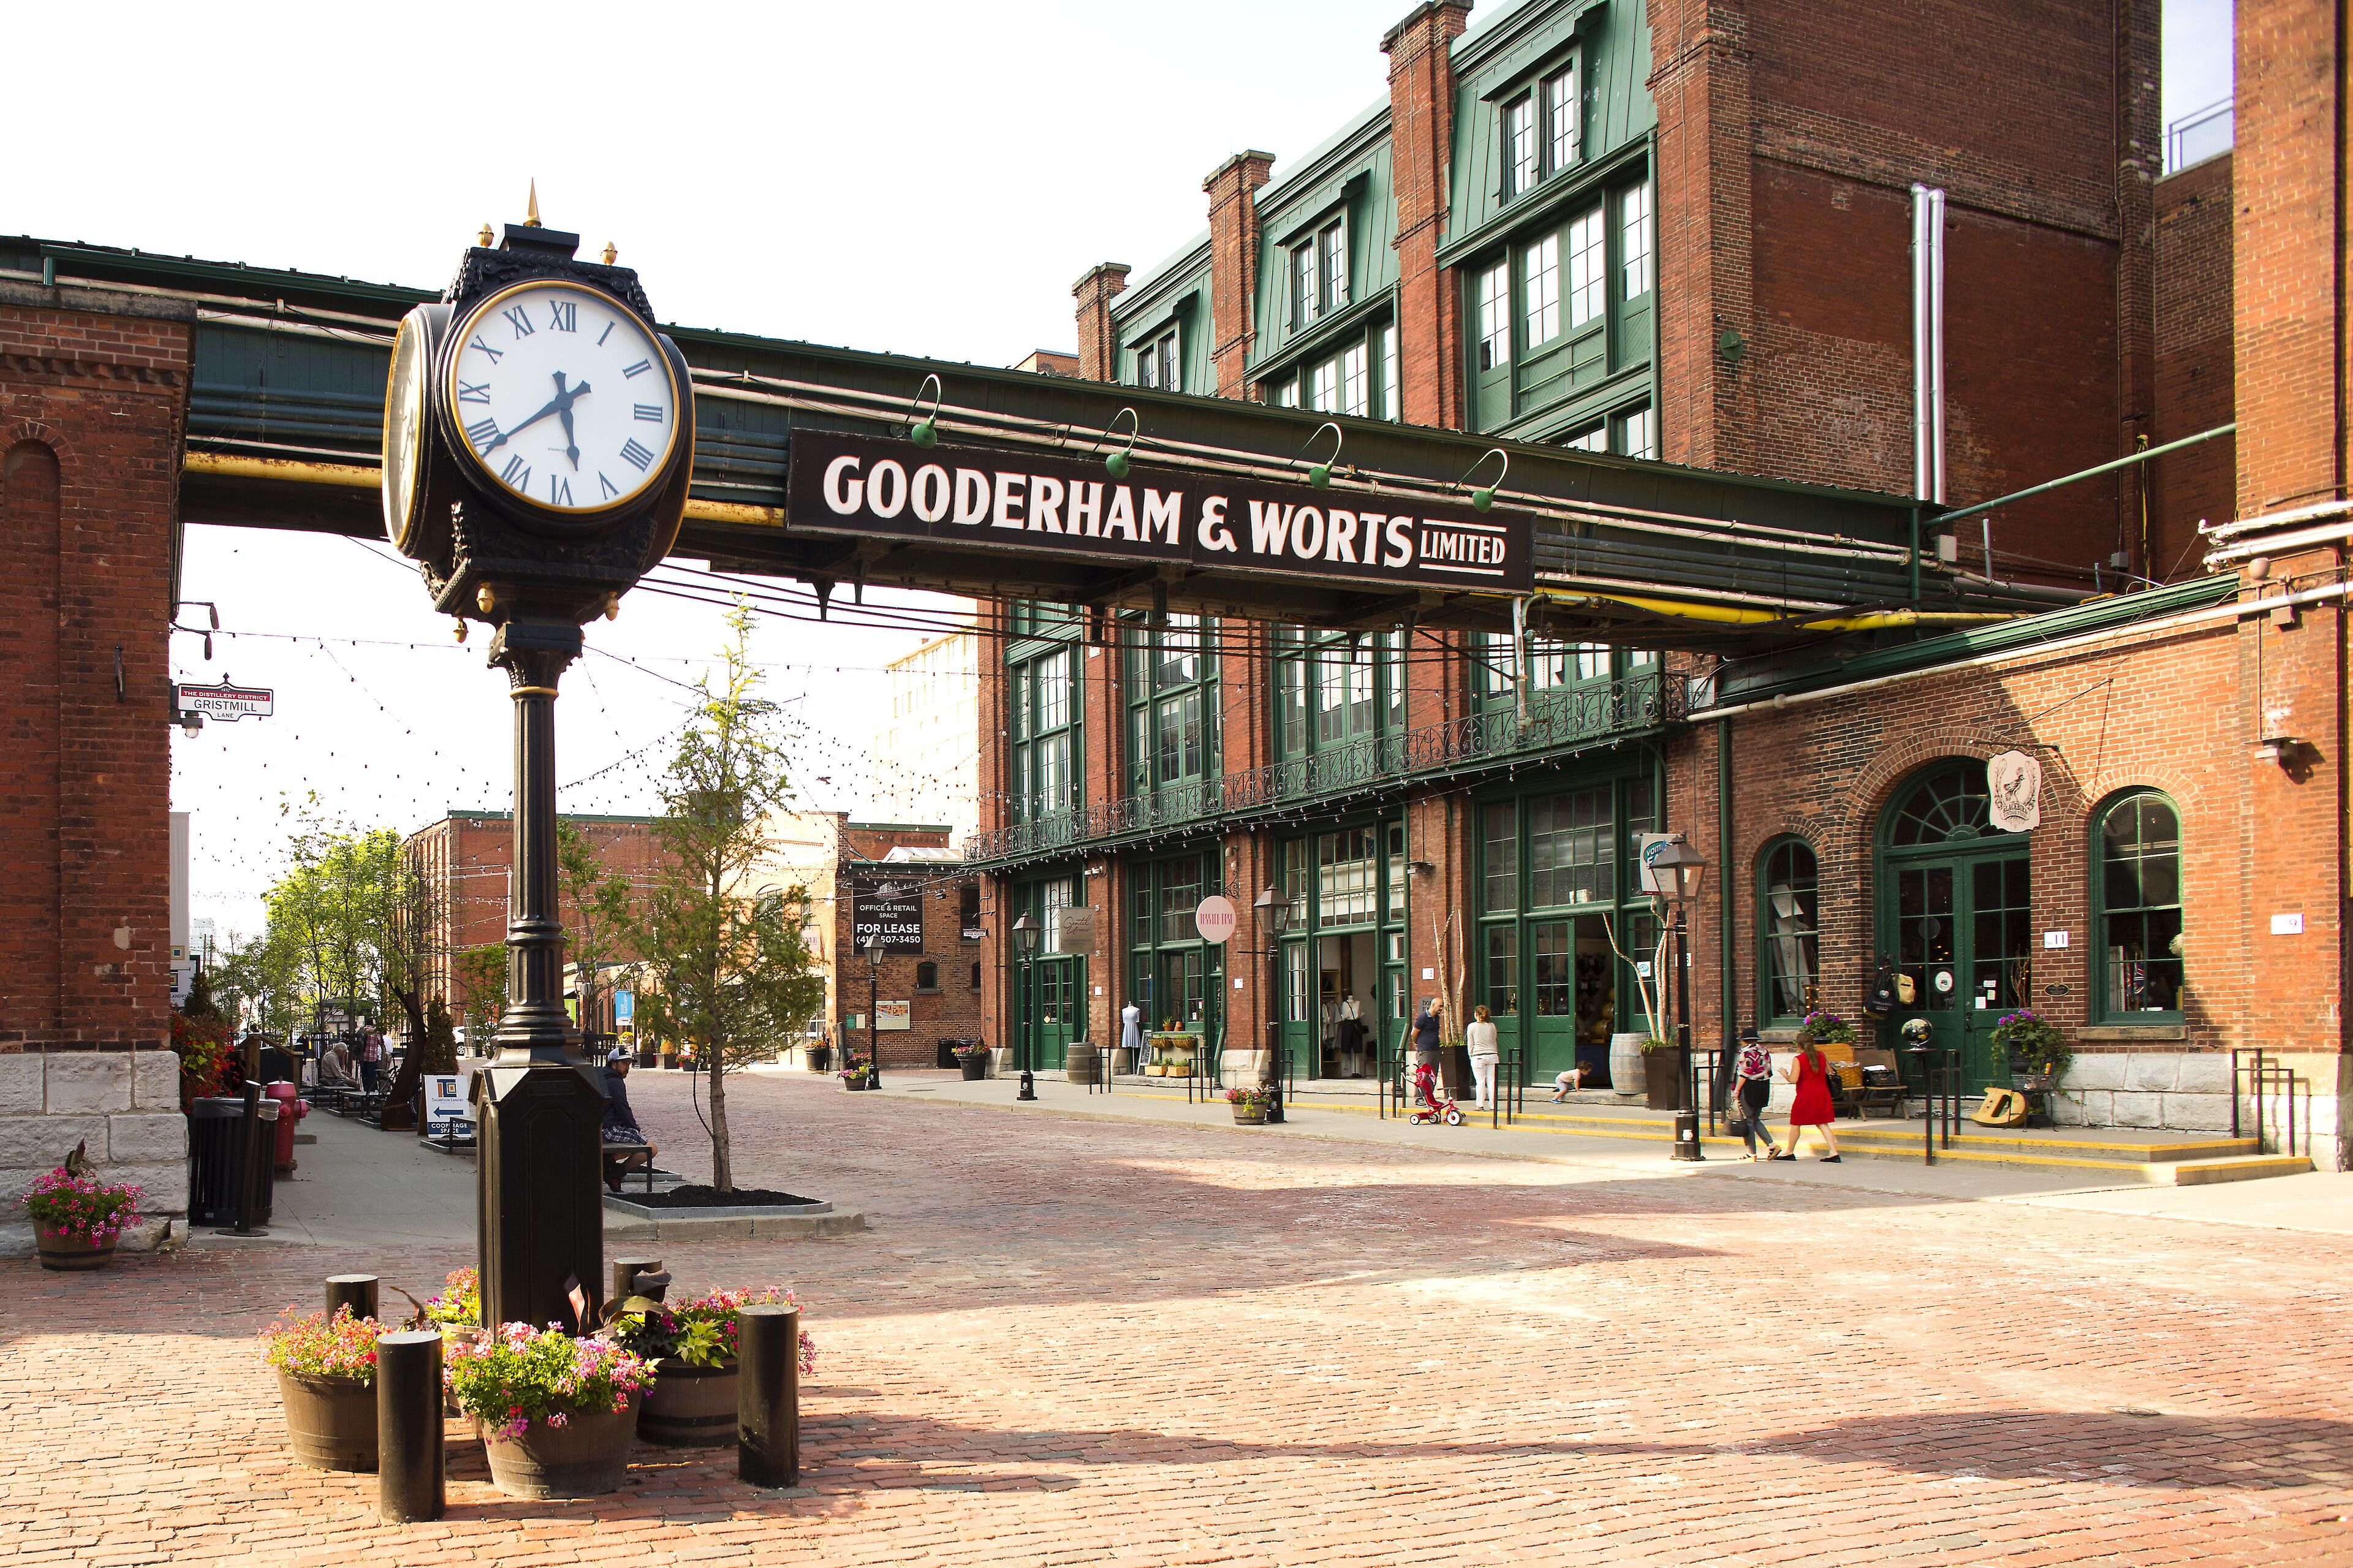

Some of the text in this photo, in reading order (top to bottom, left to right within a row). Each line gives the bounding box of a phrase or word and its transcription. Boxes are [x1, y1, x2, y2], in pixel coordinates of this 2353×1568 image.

[502, 305, 536, 339] XI
[550, 300, 577, 333] XII
[470, 335, 503, 365] X
[459, 381, 490, 404] IX
[823, 455, 1506, 569] GOODERHAM & WORTS LIMITED
[194, 699, 257, 712] GRISTMILL
[857, 923, 920, 933] FOR LEASE
[2055, 934, 2064, 944] 11
